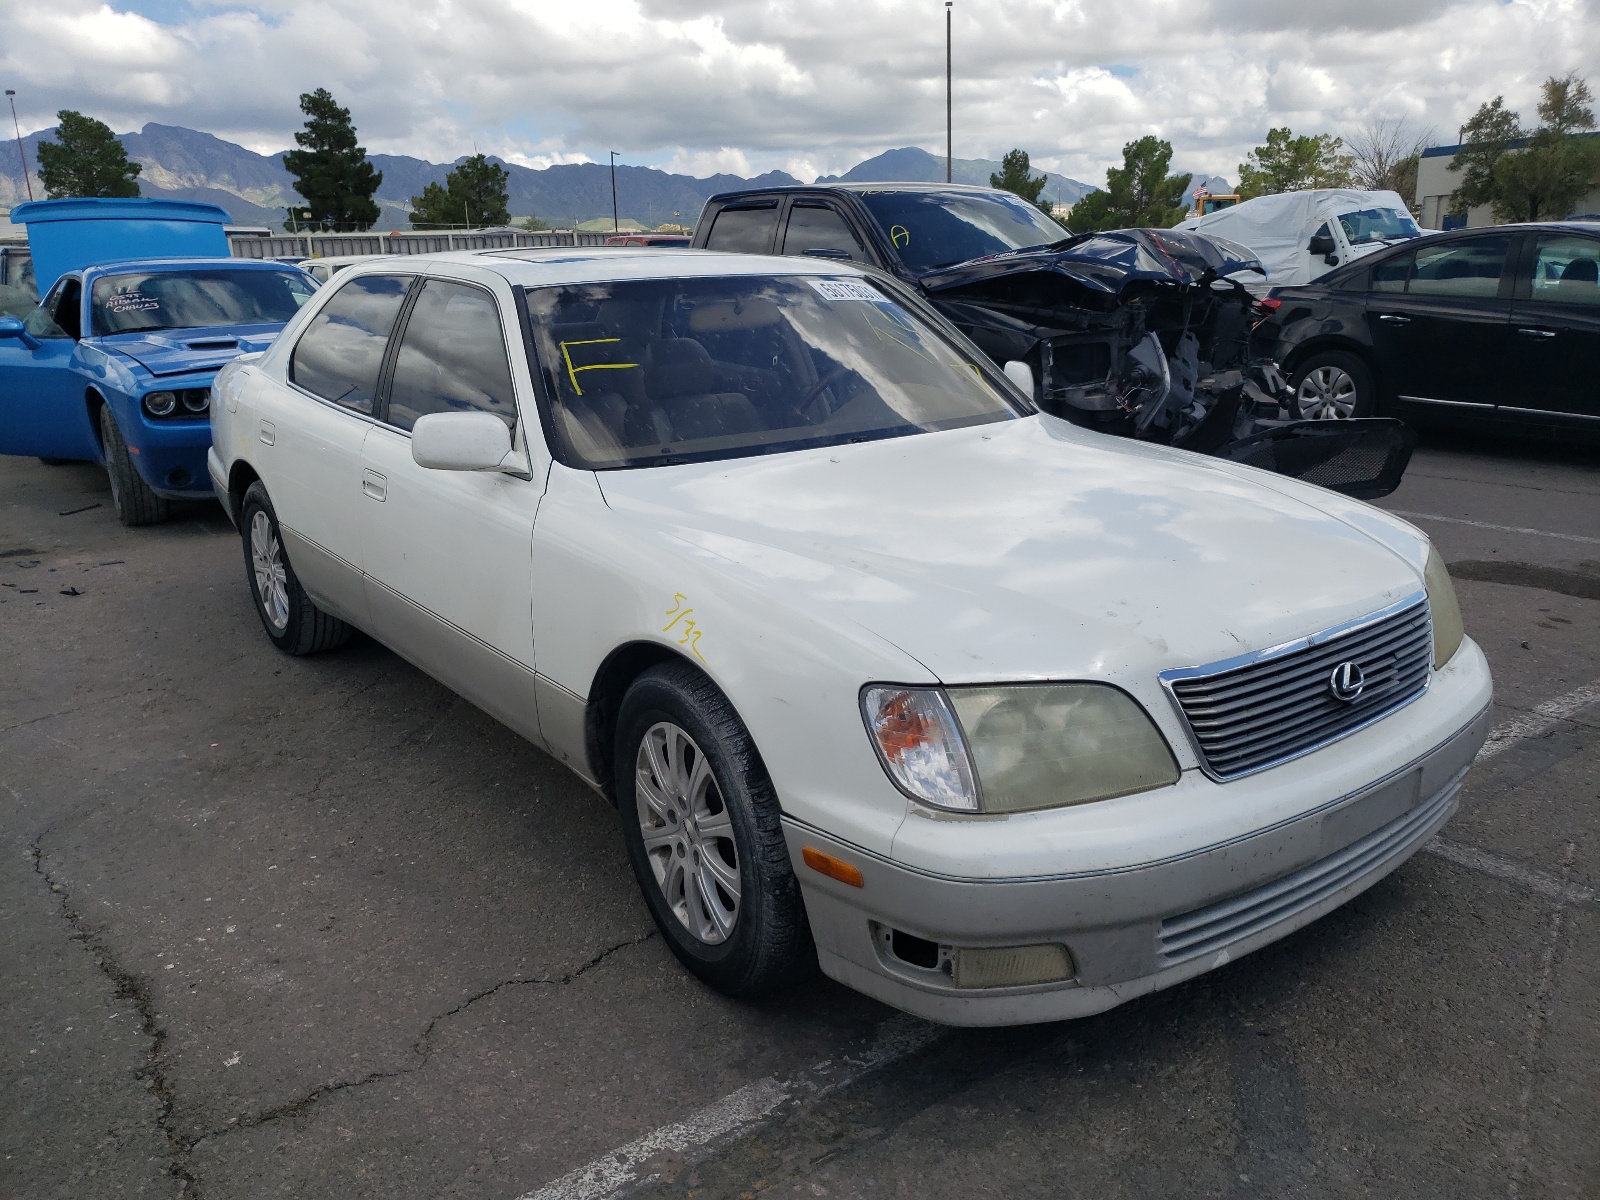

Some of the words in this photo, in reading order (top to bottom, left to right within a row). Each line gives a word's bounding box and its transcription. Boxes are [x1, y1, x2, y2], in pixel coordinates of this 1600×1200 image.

[890, 224, 910, 249] A
[819, 283, 880, 299] 56175031
[559, 338, 640, 396] F
[662, 592, 707, 664] 5/32
